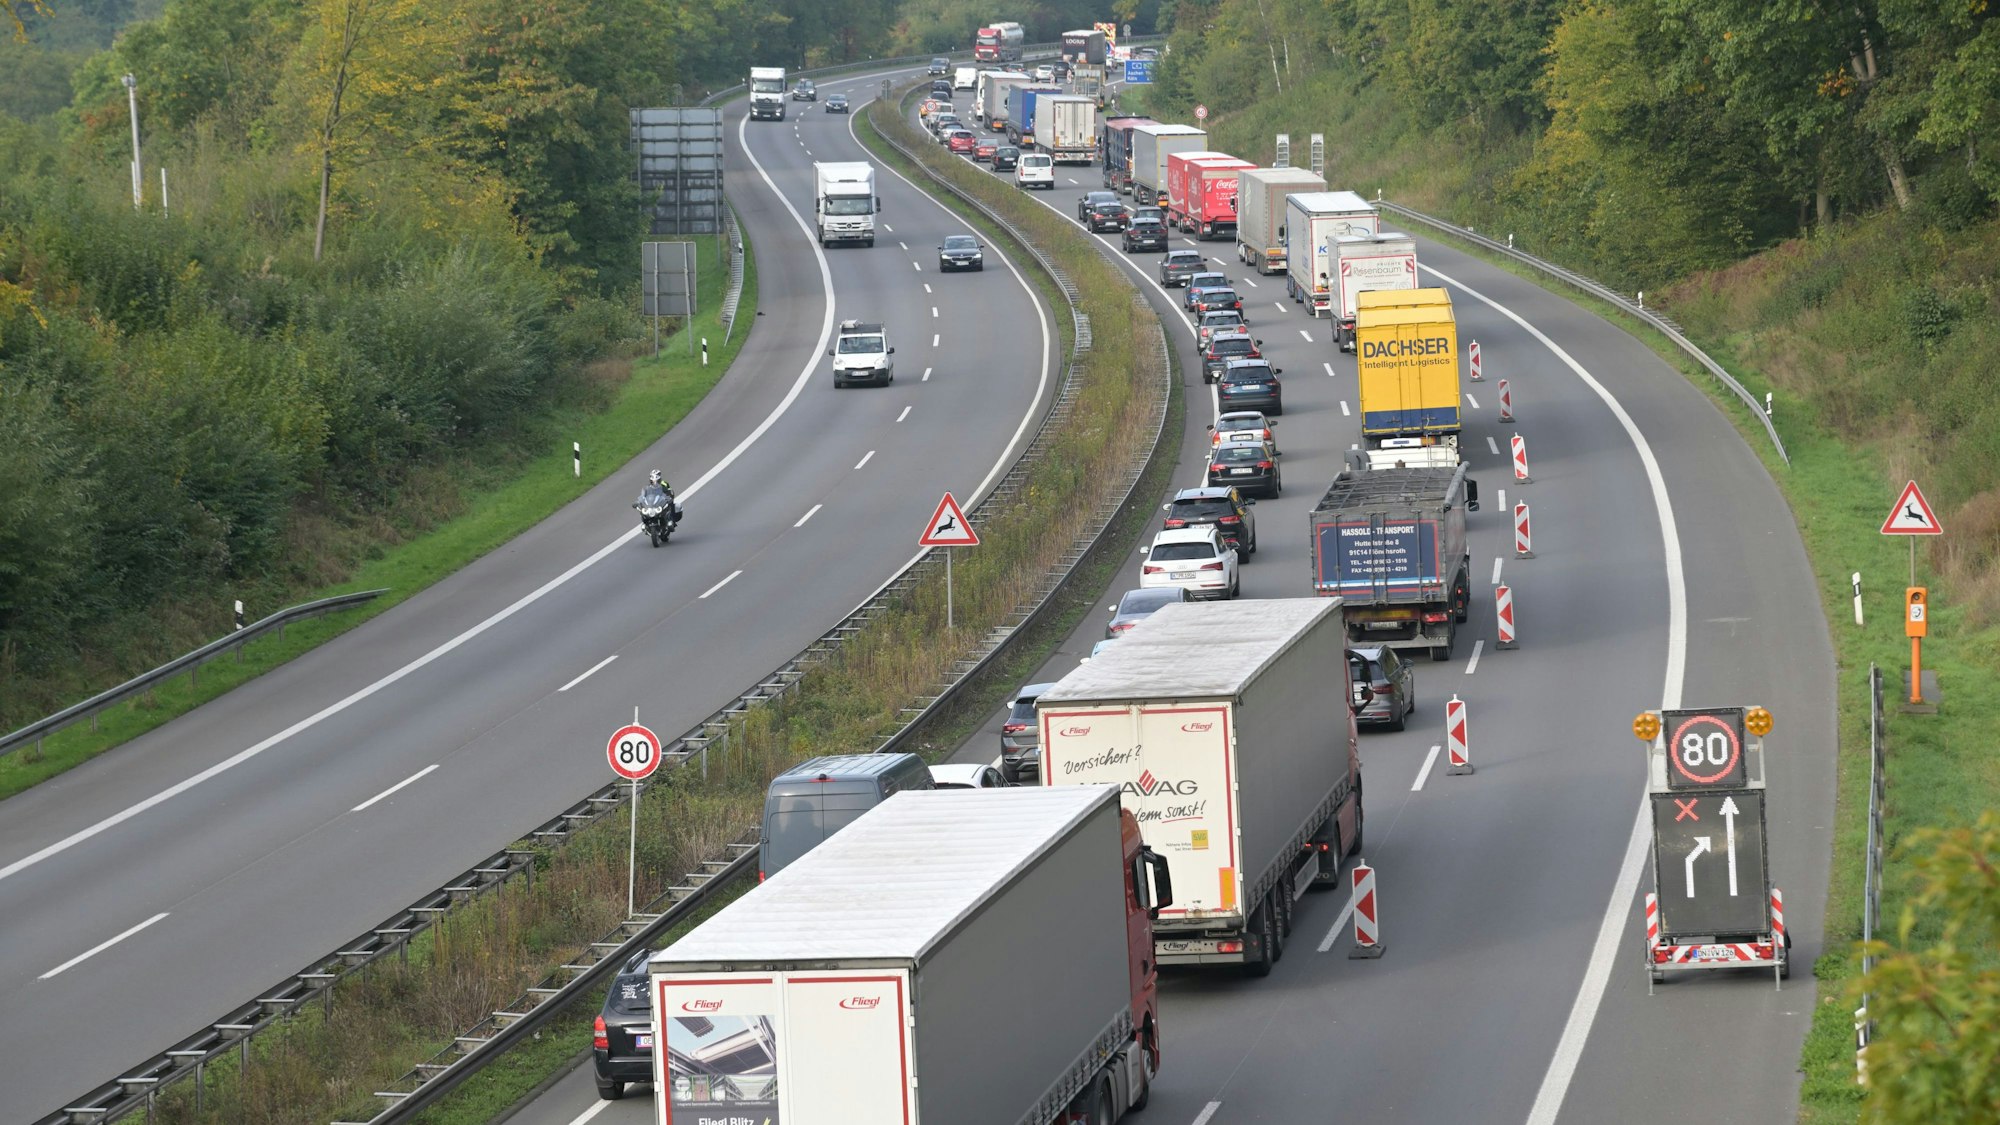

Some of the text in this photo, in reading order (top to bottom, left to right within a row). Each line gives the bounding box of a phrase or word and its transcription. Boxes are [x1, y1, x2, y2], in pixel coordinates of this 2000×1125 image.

[1364, 338, 1449, 358] DACHSER
[1364, 358, 1450, 369] Intelligent Logistics
[1342, 528, 1370, 536] HASSOLD
[1069, 726, 1090, 735] Fliegl
[1190, 722, 1212, 731] Fliegl
[621, 741, 649, 763] 80
[1683, 732, 1728, 766] 80
[1168, 942, 1188, 950] Fliegl
[694, 1000, 722, 1009] Fliegl
[852, 997, 880, 1006] Fliegl
[730, 1117, 754, 1125] Blitz
